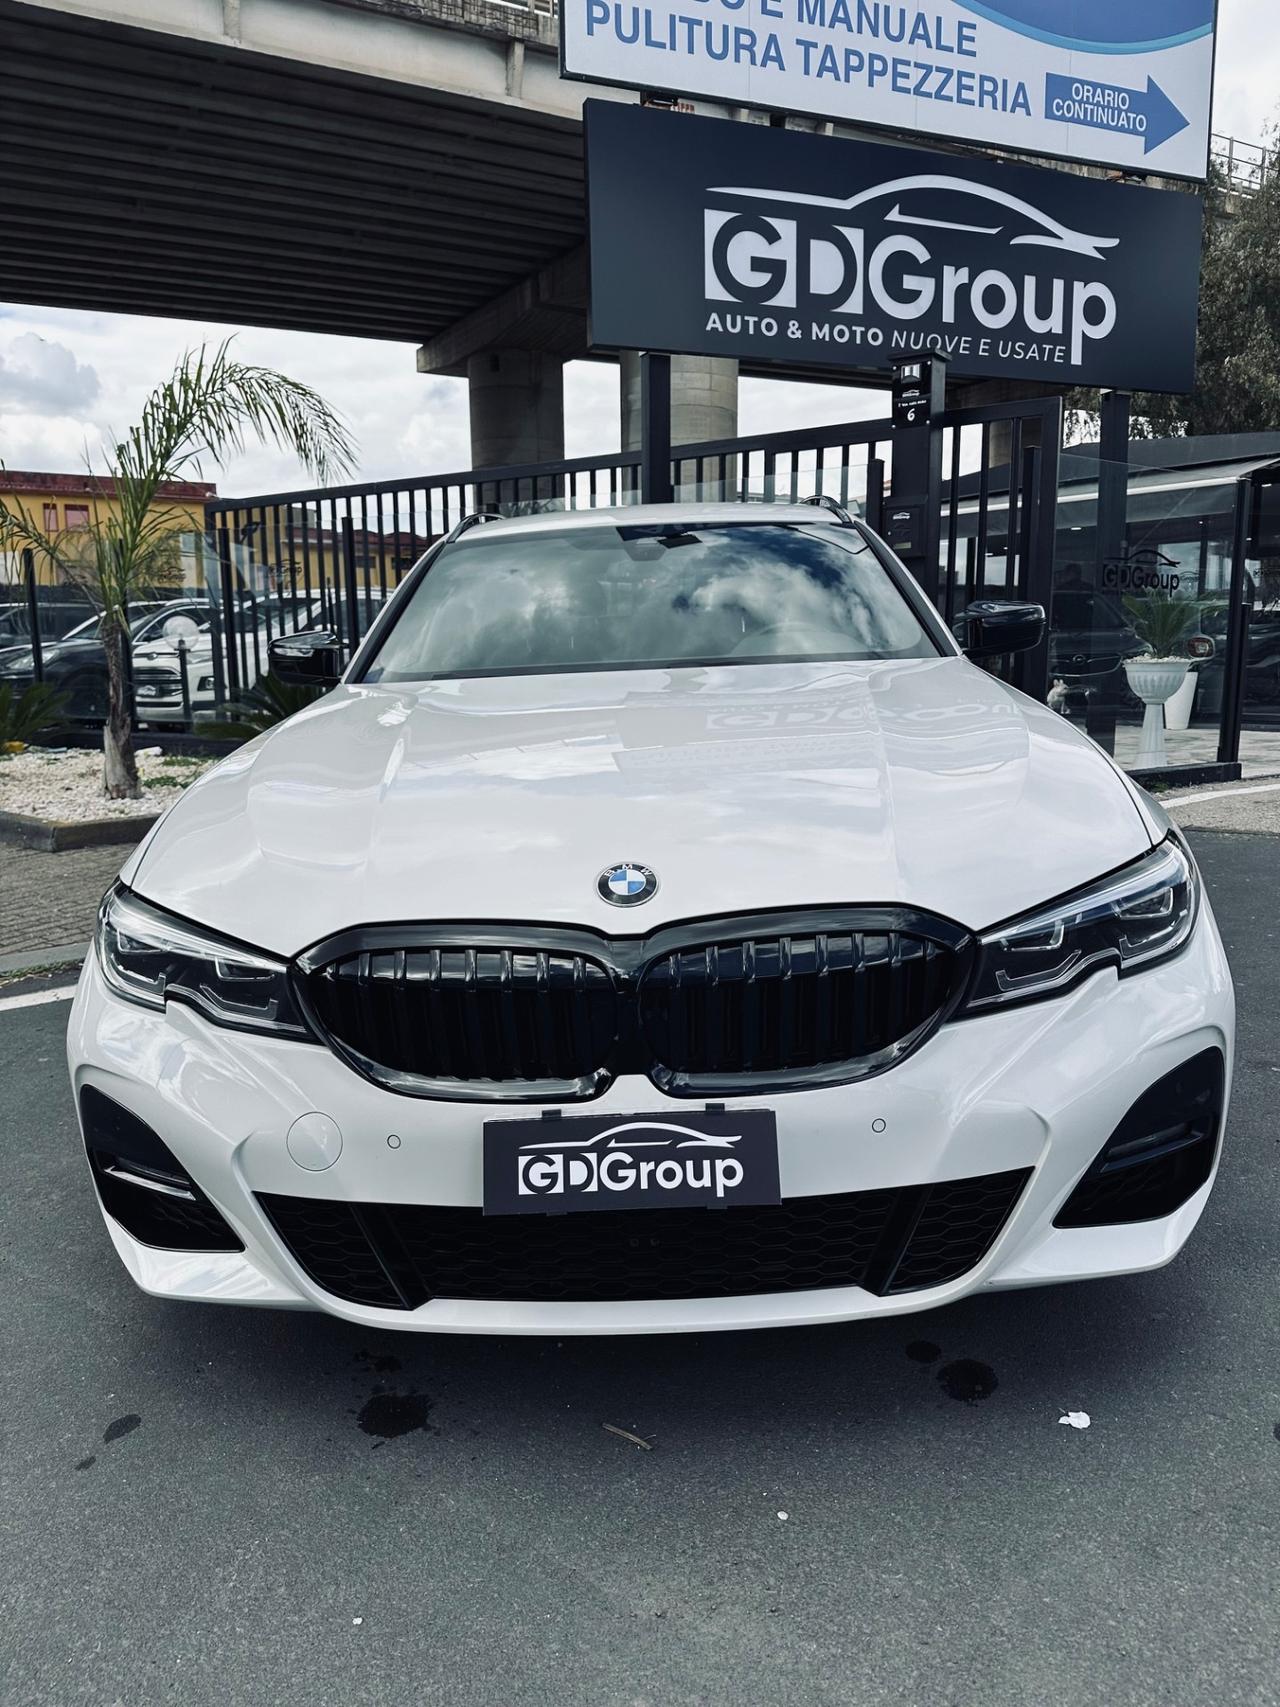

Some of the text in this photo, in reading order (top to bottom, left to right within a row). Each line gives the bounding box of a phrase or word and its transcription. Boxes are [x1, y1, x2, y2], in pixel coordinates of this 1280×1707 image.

[797, 0, 977, 58] MANUALE
[586, 0, 1032, 117] PULITURA TAPPEZZERIA
[1072, 82, 1130, 111] ORARIO
[1052, 98, 1147, 132] CONTINUATO
[705, 312, 1066, 363] AUTO & MOTO NUOVE E USATE
[907, 408, 915, 421] 6
[604, 863, 653, 876] BMW
